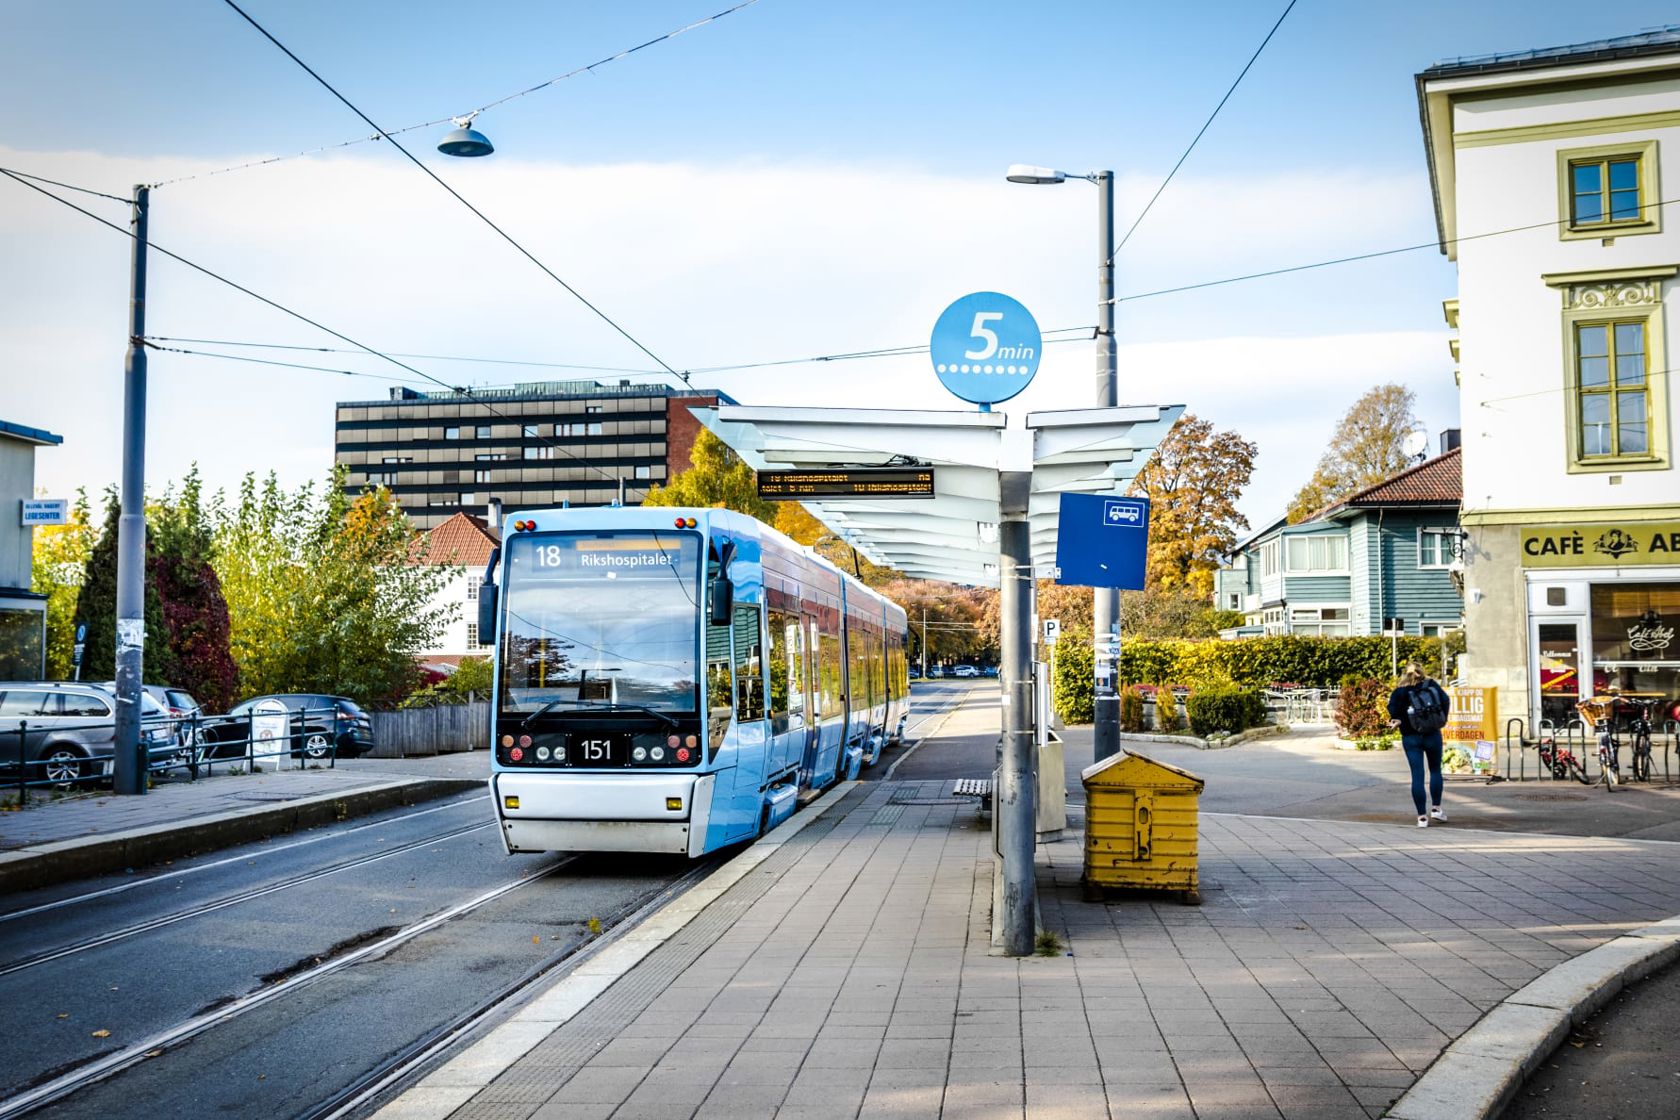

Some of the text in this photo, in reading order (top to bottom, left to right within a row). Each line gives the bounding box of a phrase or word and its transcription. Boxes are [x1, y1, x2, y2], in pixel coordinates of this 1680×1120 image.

[964, 311, 1034, 361] 5 min
[536, 545, 672, 570] 18 Rikshospitalet
[1046, 621, 1056, 636] P
[1450, 696, 1484, 714] ILLIG
[581, 740, 611, 760] 151
